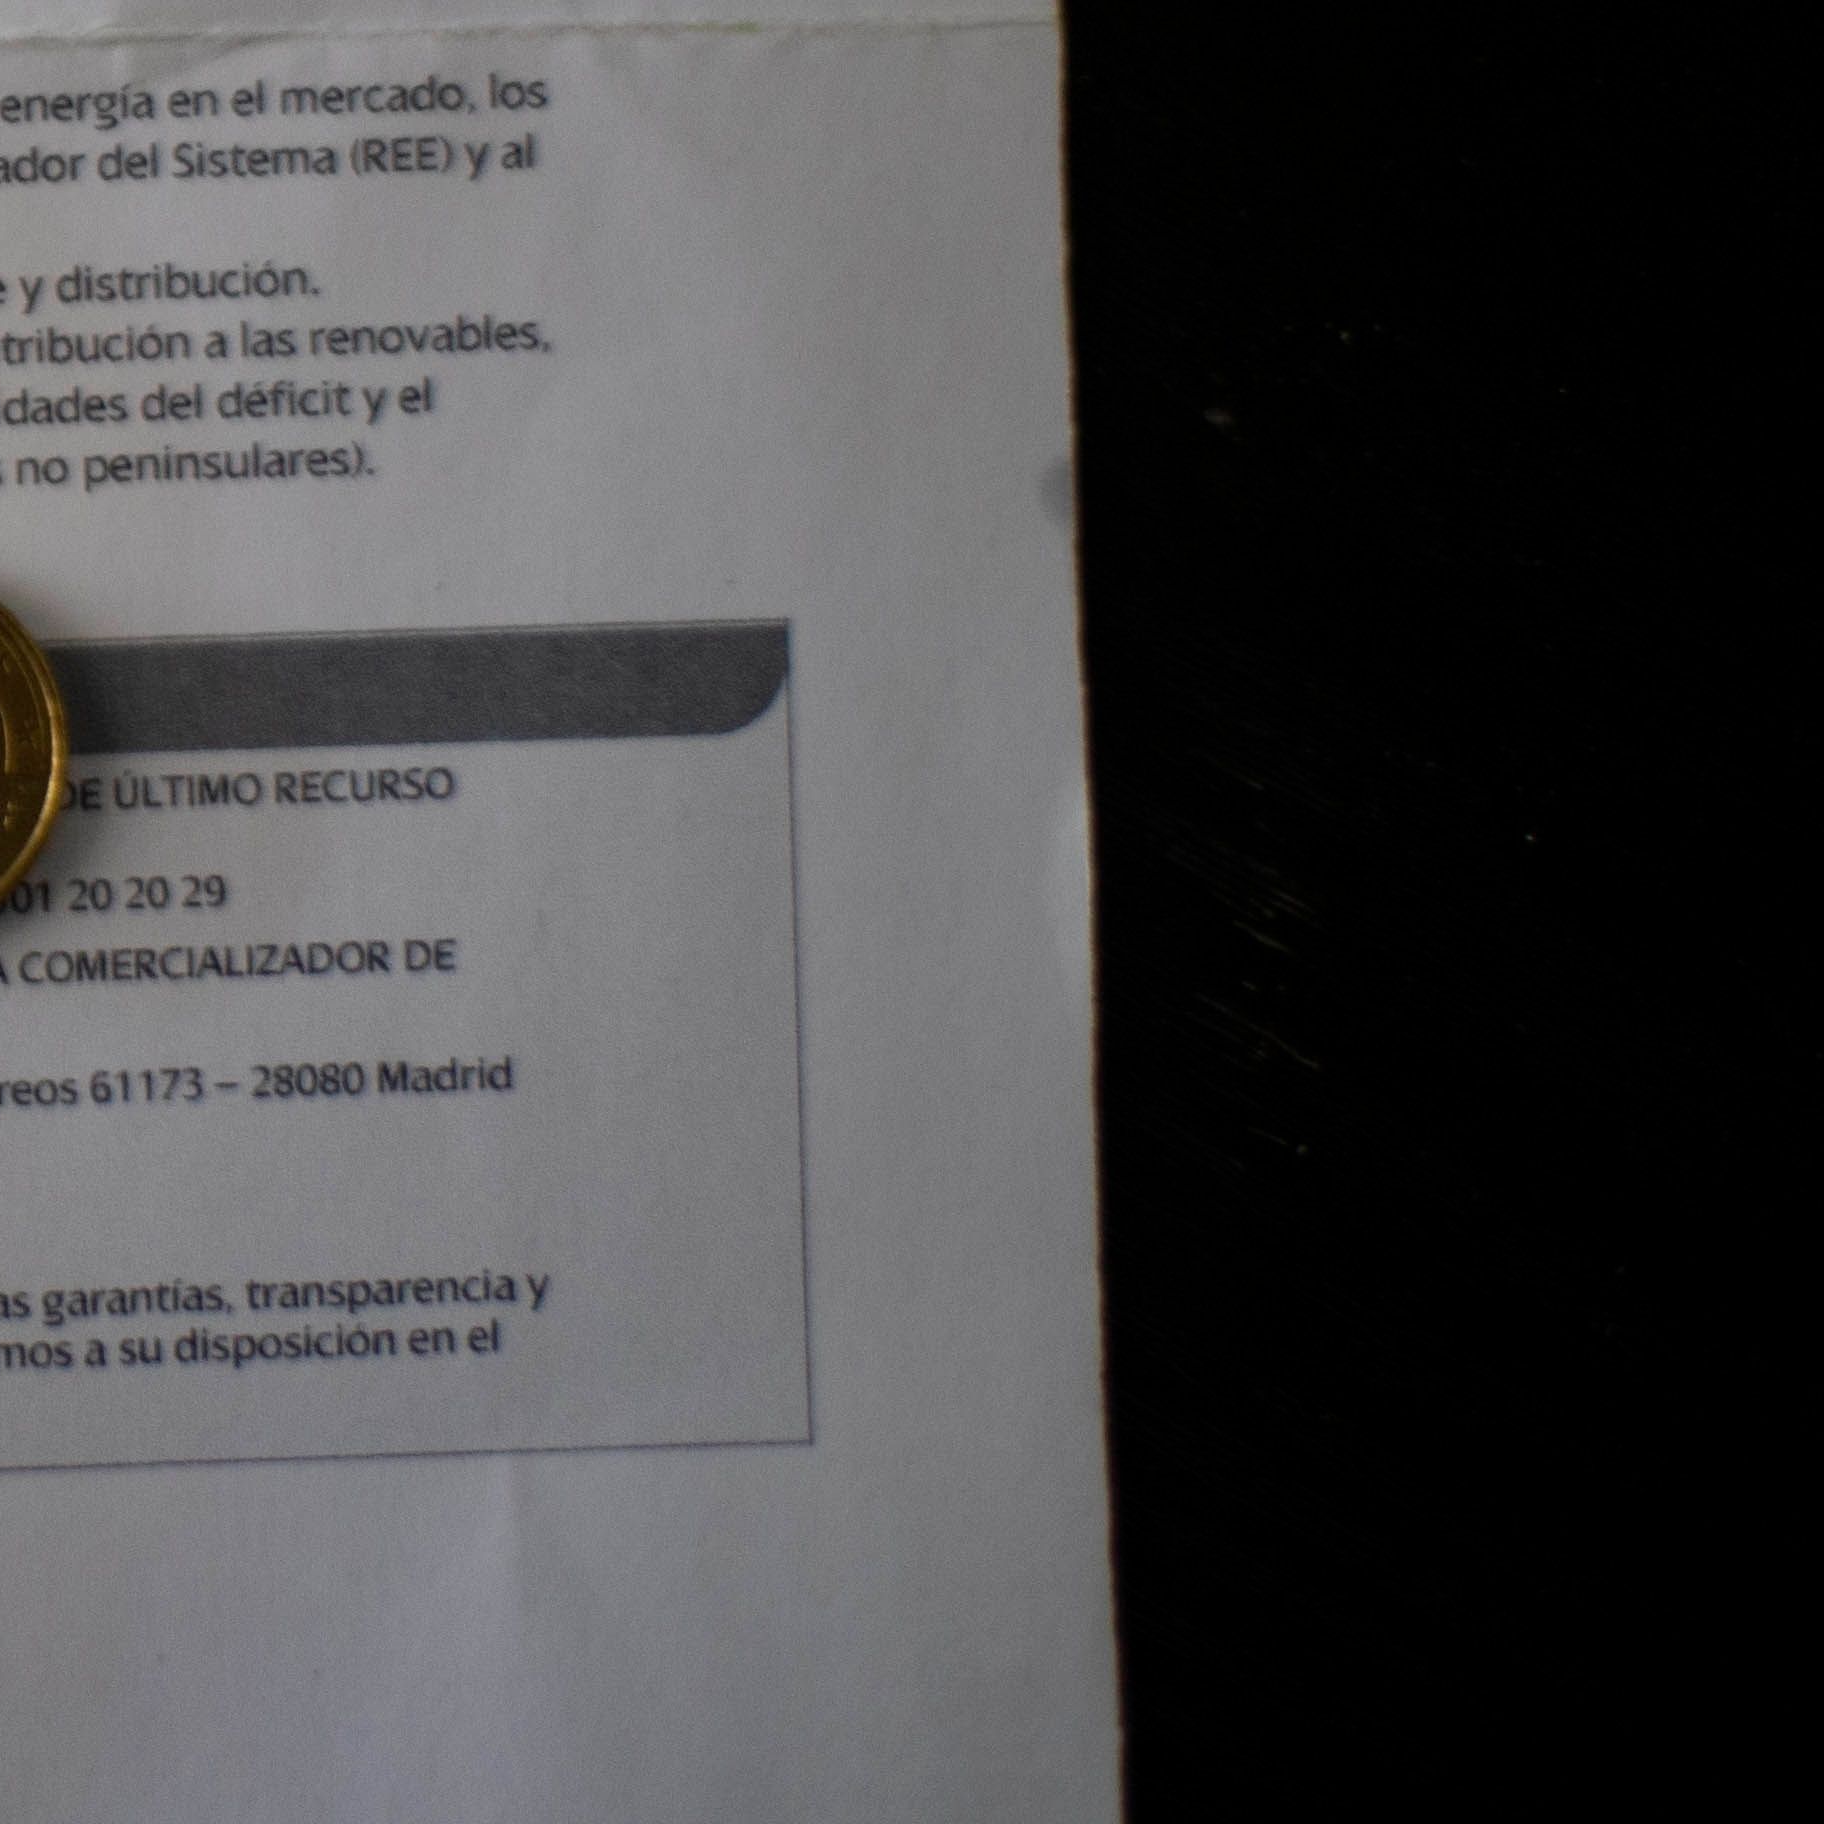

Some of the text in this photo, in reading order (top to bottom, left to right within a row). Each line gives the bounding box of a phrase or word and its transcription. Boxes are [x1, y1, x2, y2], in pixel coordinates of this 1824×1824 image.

[168, 88, 220, 119] en
[231, 80, 267, 118] el
[280, 75, 476, 115] mercado,
[489, 73, 549, 111] los
[87, 1065, 208, 1104] 61173
[251, 1061, 370, 1102] 28080
[377, 1056, 515, 1096] Madrid
[41, 1284, 233, 1328] garantías,
[245, 1270, 518, 1315] transparencia
[526, 1275, 550, 1312] y
